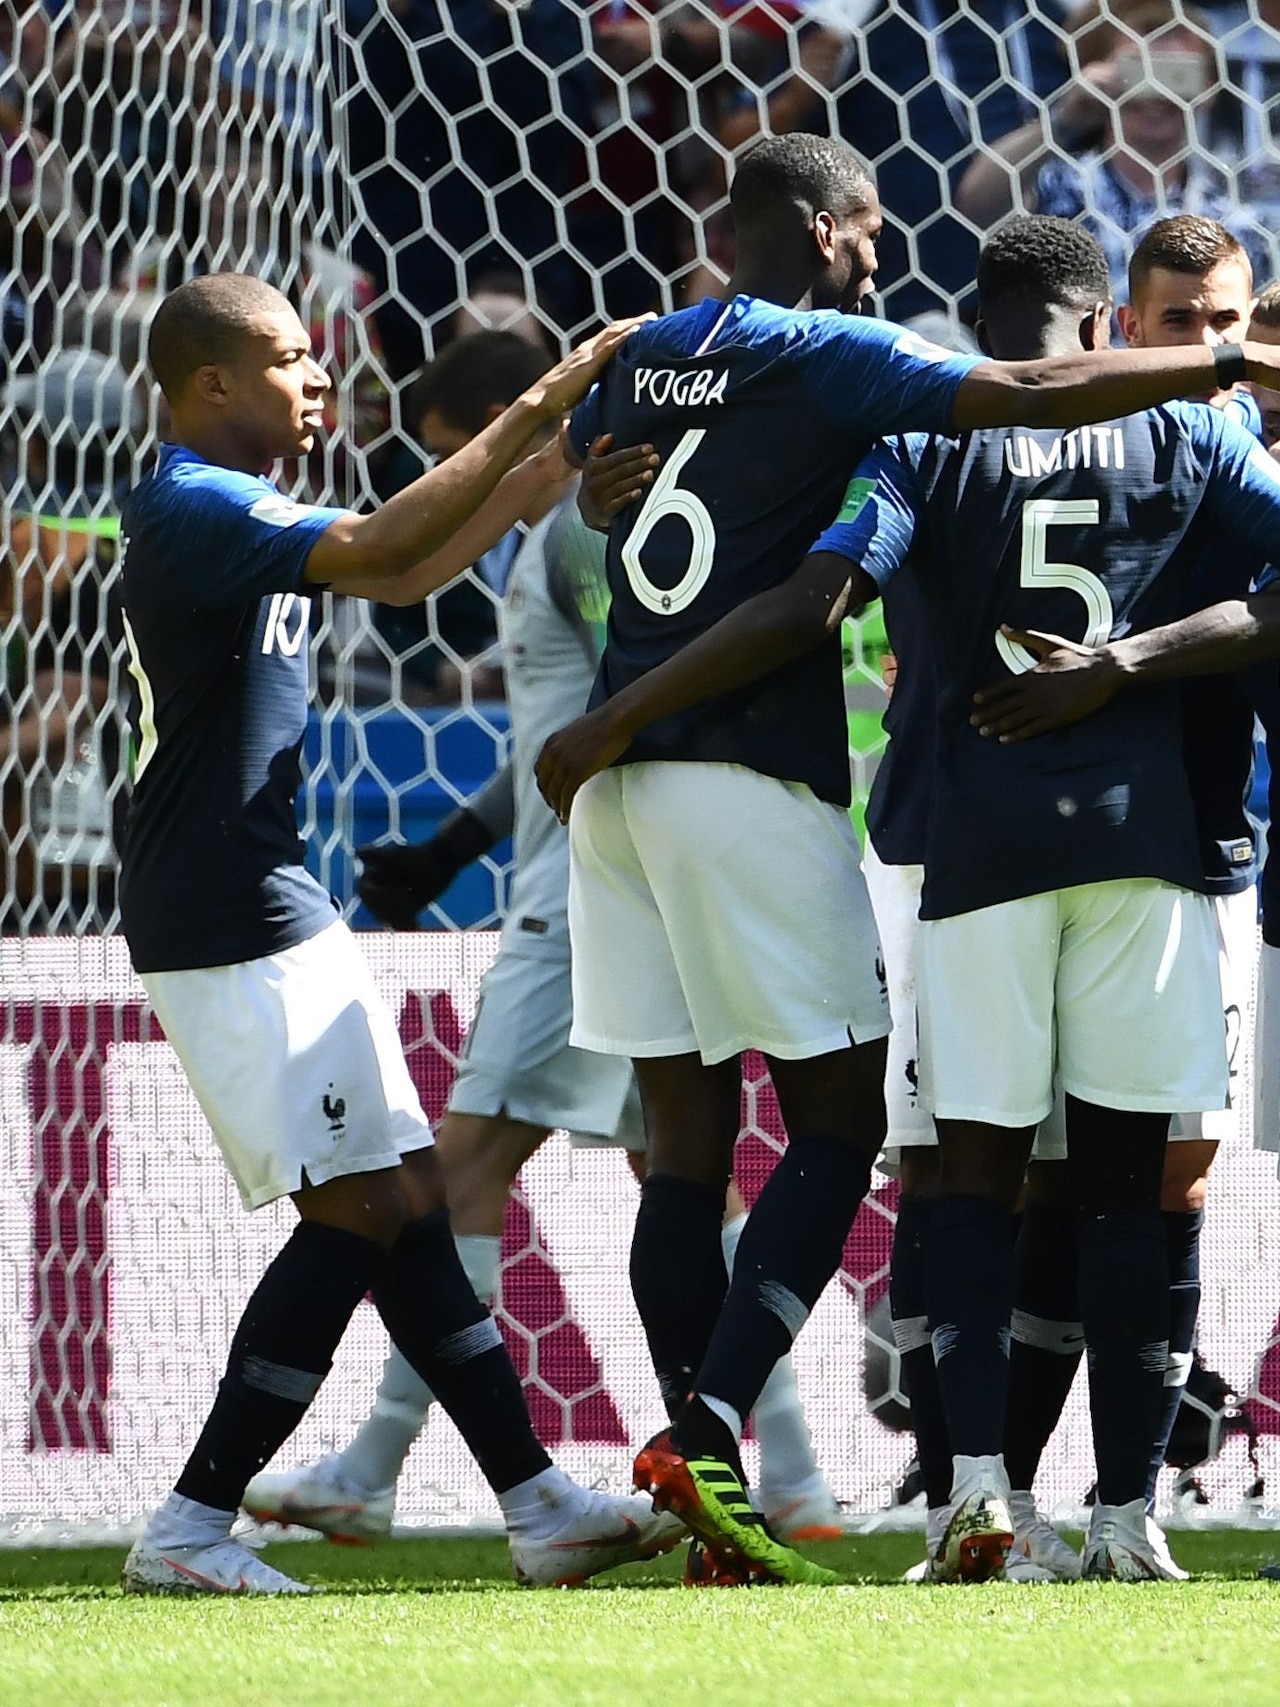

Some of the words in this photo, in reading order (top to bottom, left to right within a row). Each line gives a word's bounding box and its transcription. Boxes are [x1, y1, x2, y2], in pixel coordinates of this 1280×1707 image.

[1005, 426, 1124, 478] UMTITI
[621, 429, 716, 616] 6
[261, 593, 311, 657] 10
[995, 499, 1113, 676] 5
